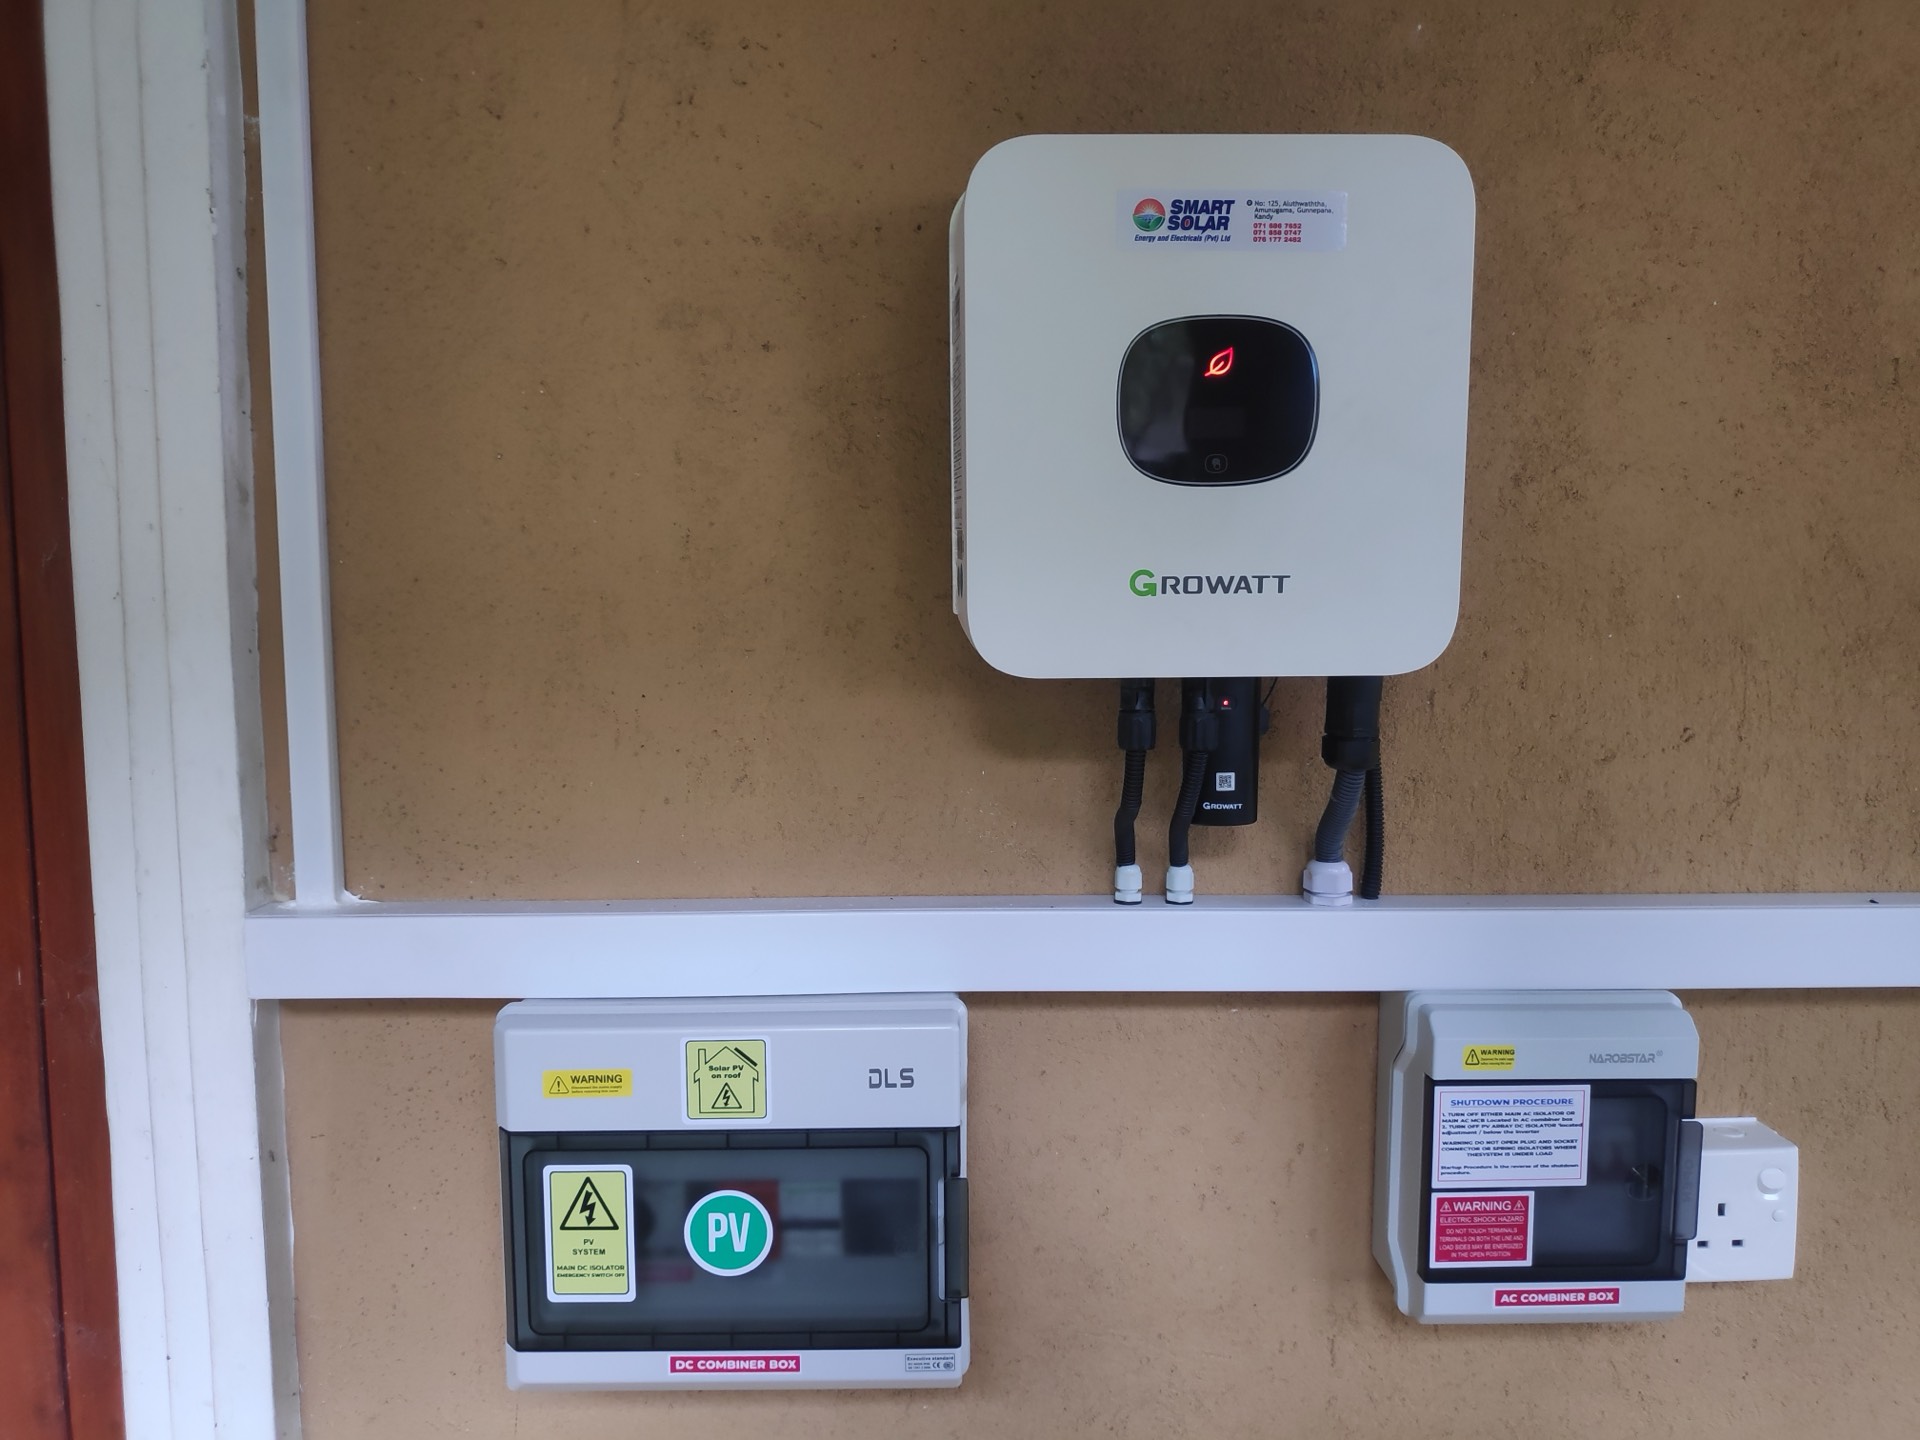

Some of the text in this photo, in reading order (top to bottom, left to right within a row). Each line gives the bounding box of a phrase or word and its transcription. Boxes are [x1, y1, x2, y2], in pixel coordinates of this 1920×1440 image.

[1170, 199, 1235, 215] SMART
[1167, 215, 1230, 234] SOLAR
[1134, 234, 1156, 242] Energy
[1129, 569, 1291, 597] GROWATT
[570, 1074, 622, 1084] WARNING
[869, 1068, 914, 1088] DLS
[1453, 1200, 1512, 1212] WARNING
[707, 1212, 750, 1252] PV
[1500, 1292, 1614, 1302] AC COMBINER BOX
[676, 1360, 796, 1370] DC COMBINER BOX
